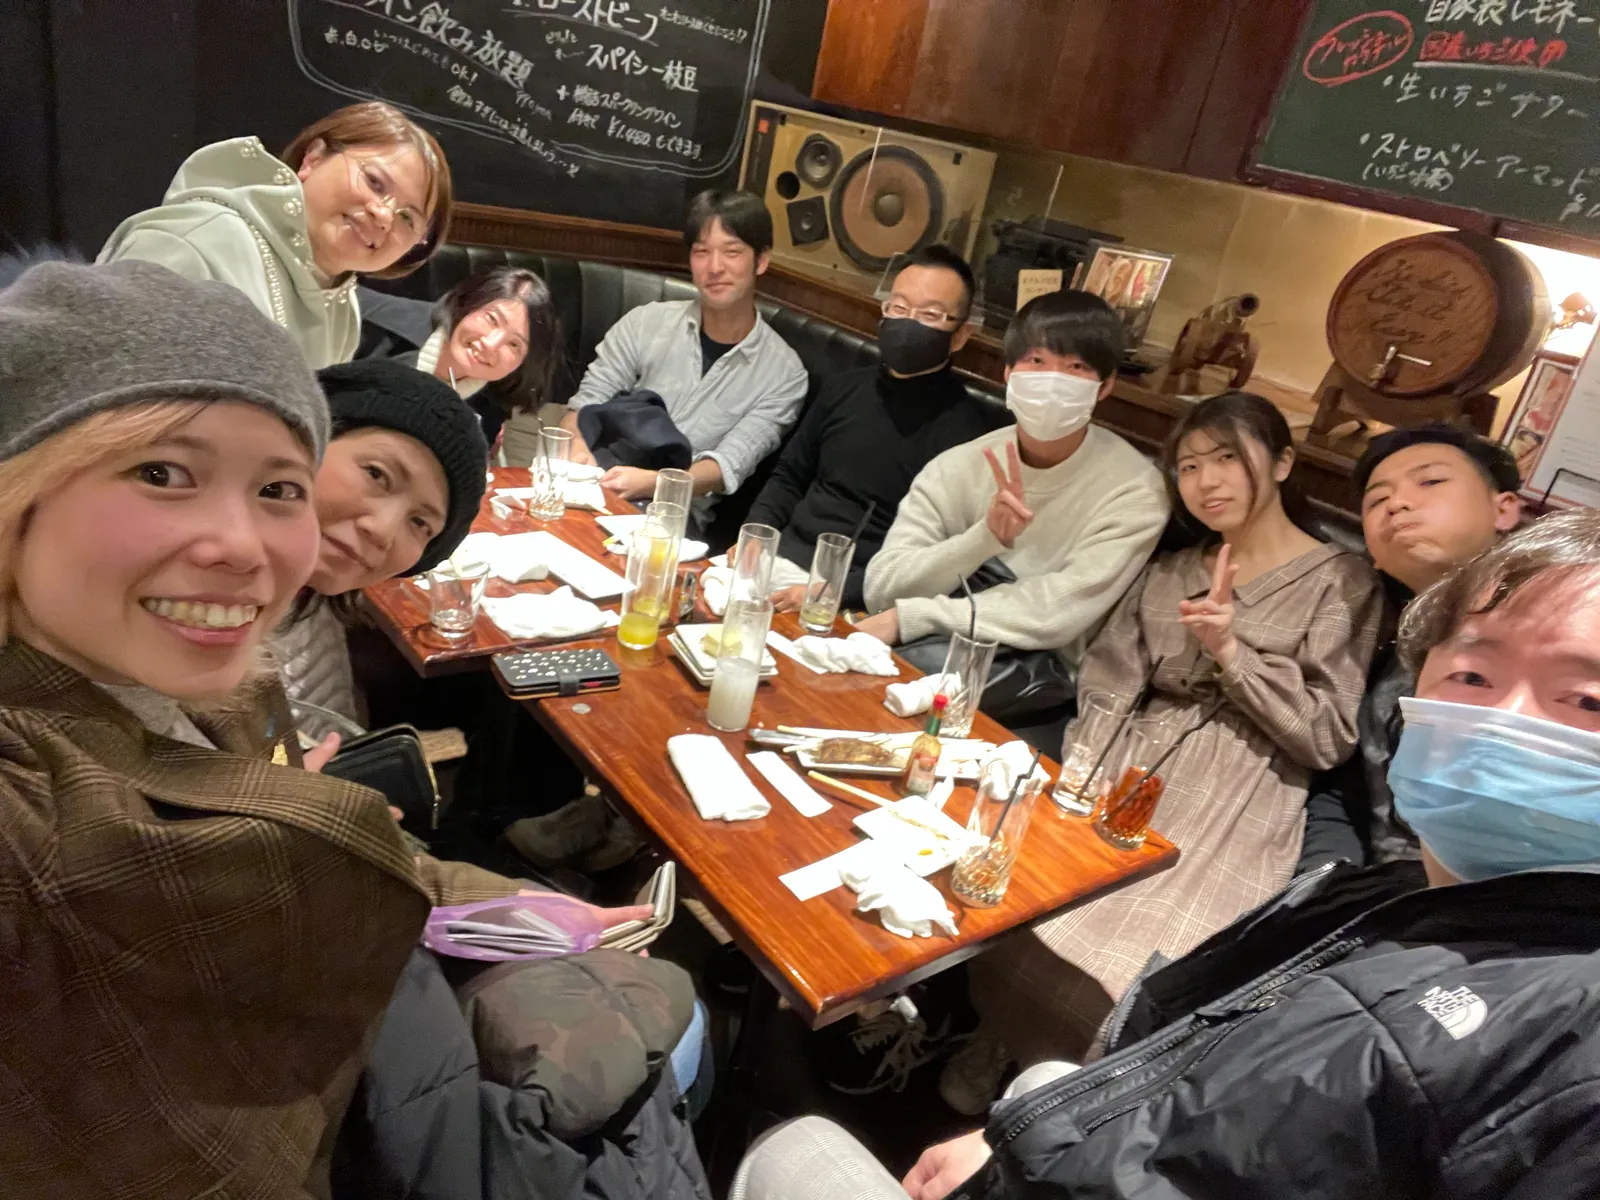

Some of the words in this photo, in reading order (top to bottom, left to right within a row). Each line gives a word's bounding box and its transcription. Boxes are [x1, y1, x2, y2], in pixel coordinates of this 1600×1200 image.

[586, 44, 699, 92] スパイシー枝豆
[1450, 985, 1481, 1005] THE
[1417, 997, 1449, 1018] FACE
